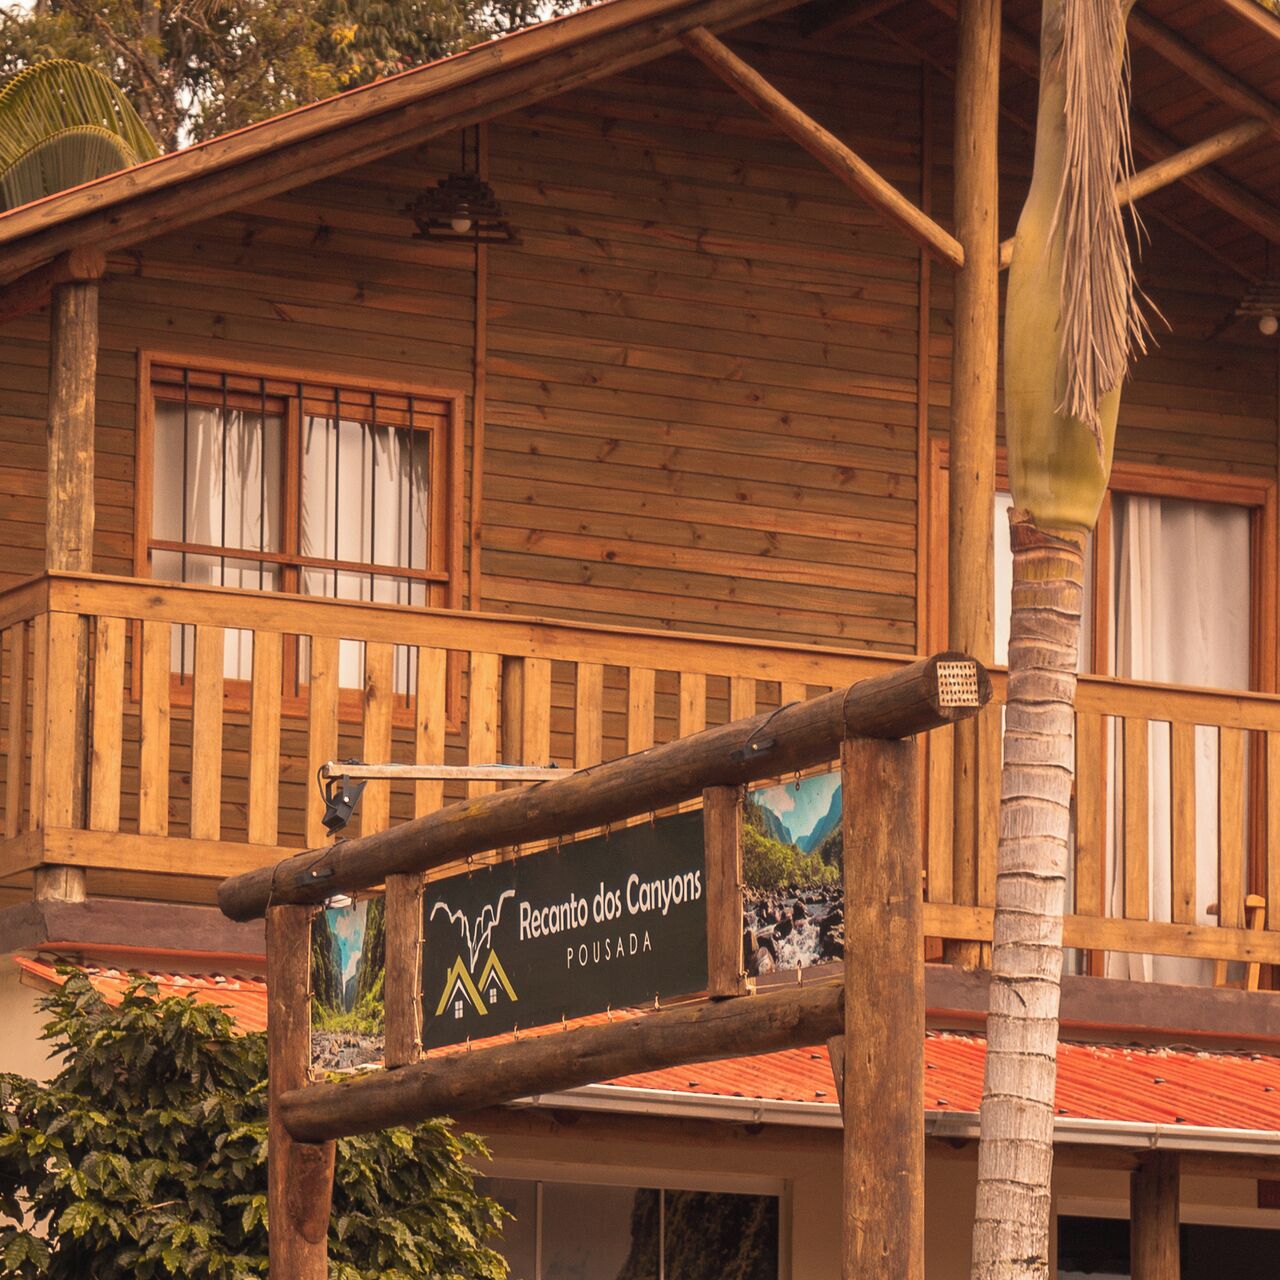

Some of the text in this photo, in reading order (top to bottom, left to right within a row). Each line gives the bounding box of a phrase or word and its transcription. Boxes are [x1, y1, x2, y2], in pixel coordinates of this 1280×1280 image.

[519, 870, 702, 941] Recanto dos Canyons
[567, 930, 652, 969] POUSADA
